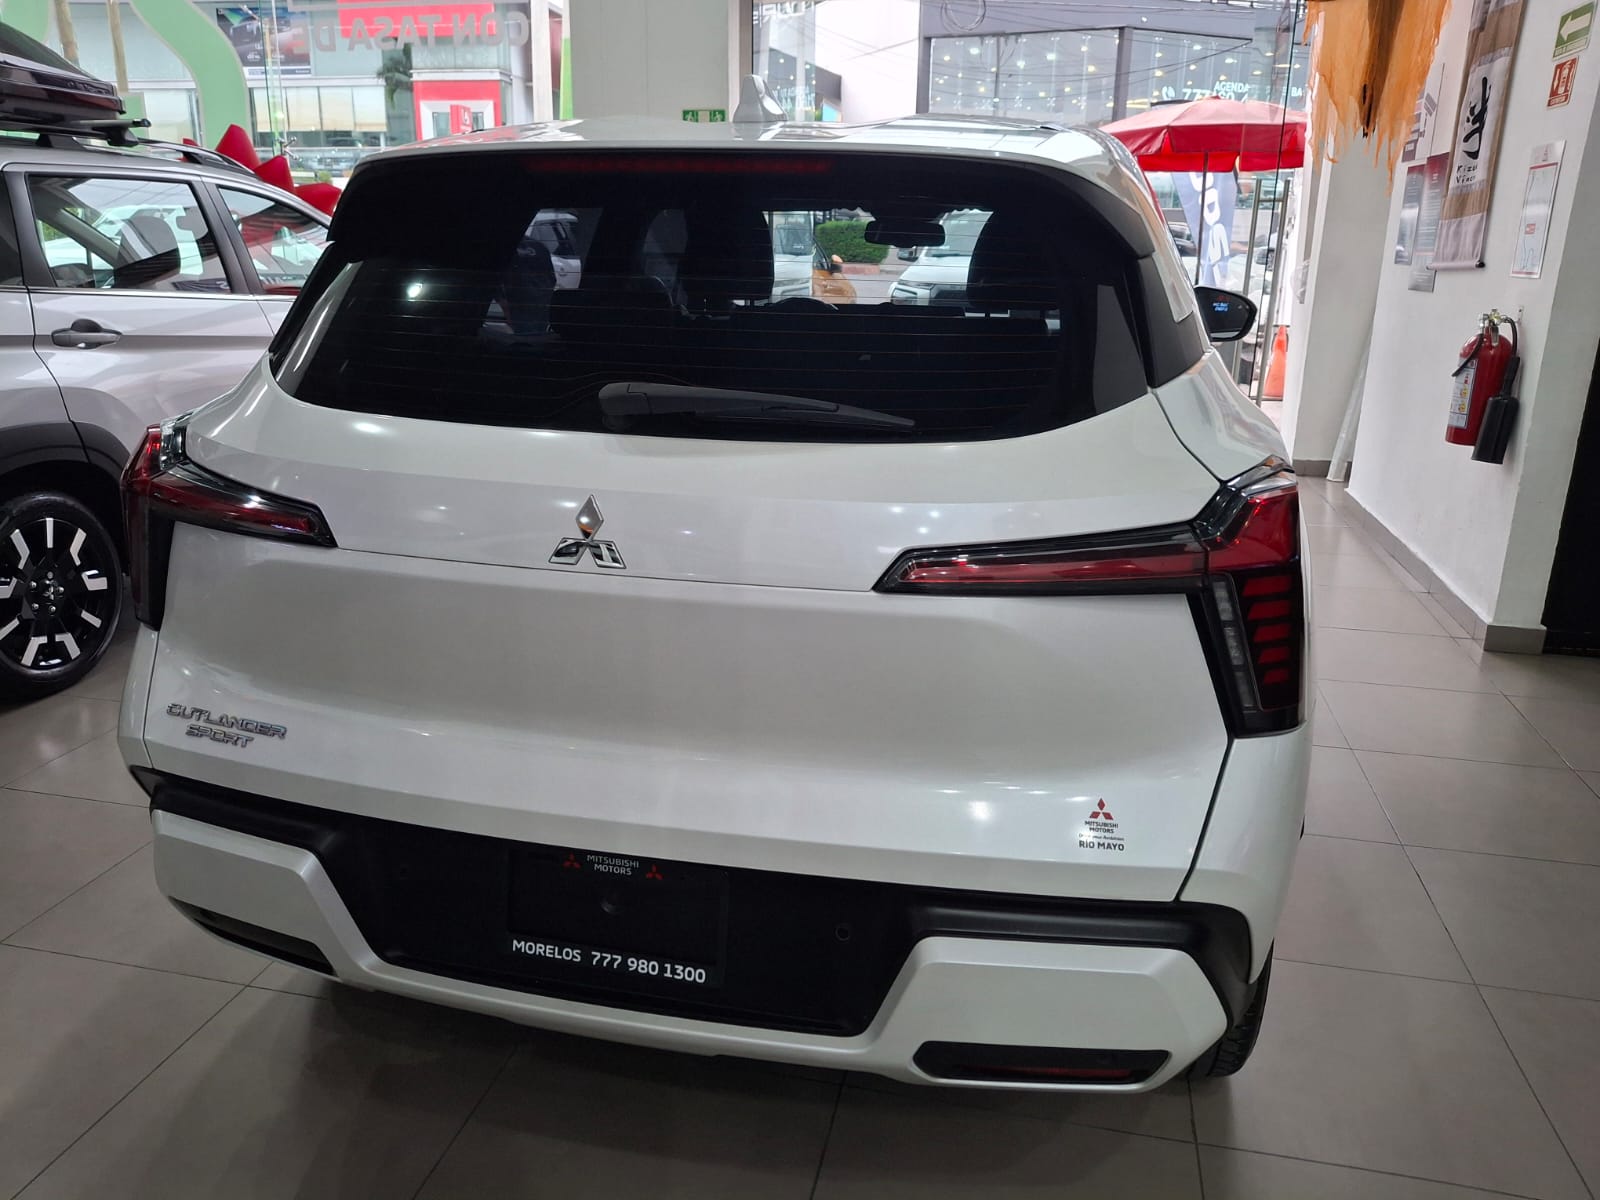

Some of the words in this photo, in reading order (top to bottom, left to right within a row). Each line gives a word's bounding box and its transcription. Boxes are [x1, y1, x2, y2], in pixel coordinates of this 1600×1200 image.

[1214, 81, 1249, 93] AGENDA
[166, 703, 288, 740] OUTLANDER
[185, 723, 255, 748] SPORT
[1084, 820, 1119, 829] MITSUBISHI
[1097, 841, 1125, 851] MAYO
[587, 854, 640, 869] MITSUBISHI
[594, 864, 633, 876] MOTORS
[512, 939, 582, 962] MORELOS
[591, 951, 622, 969] 777
[627, 957, 659, 976] 980
[663, 963, 706, 983] 1300
